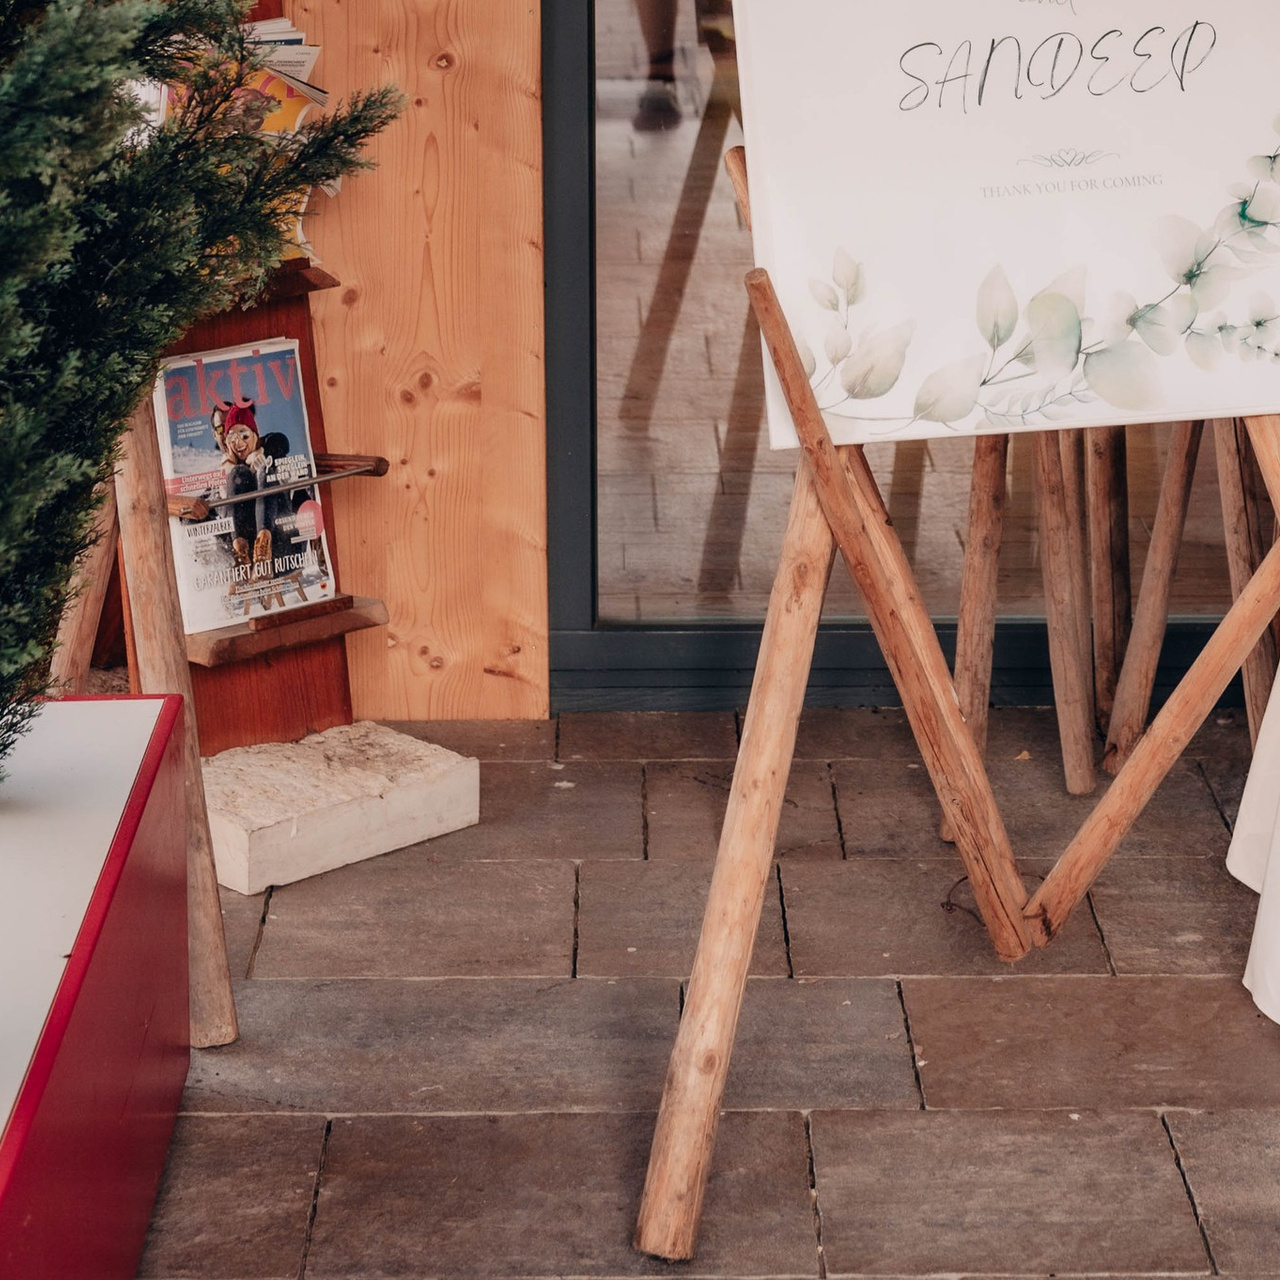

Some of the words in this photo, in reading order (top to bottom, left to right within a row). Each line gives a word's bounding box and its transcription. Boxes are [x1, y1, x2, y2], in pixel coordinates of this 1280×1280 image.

[899, 20, 1217, 114] SANDEEP
[979, 183, 1032, 198] THANK
[1035, 181, 1067, 195] YOU
[1070, 179, 1099, 192] FOR
[1102, 174, 1164, 190] COMING
[165, 349, 296, 421] aktiv
[186, 520, 233, 538] WINTERZAUBER
[194, 563, 252, 592] GARANTIERT
[255, 559, 272, 578] GUT
